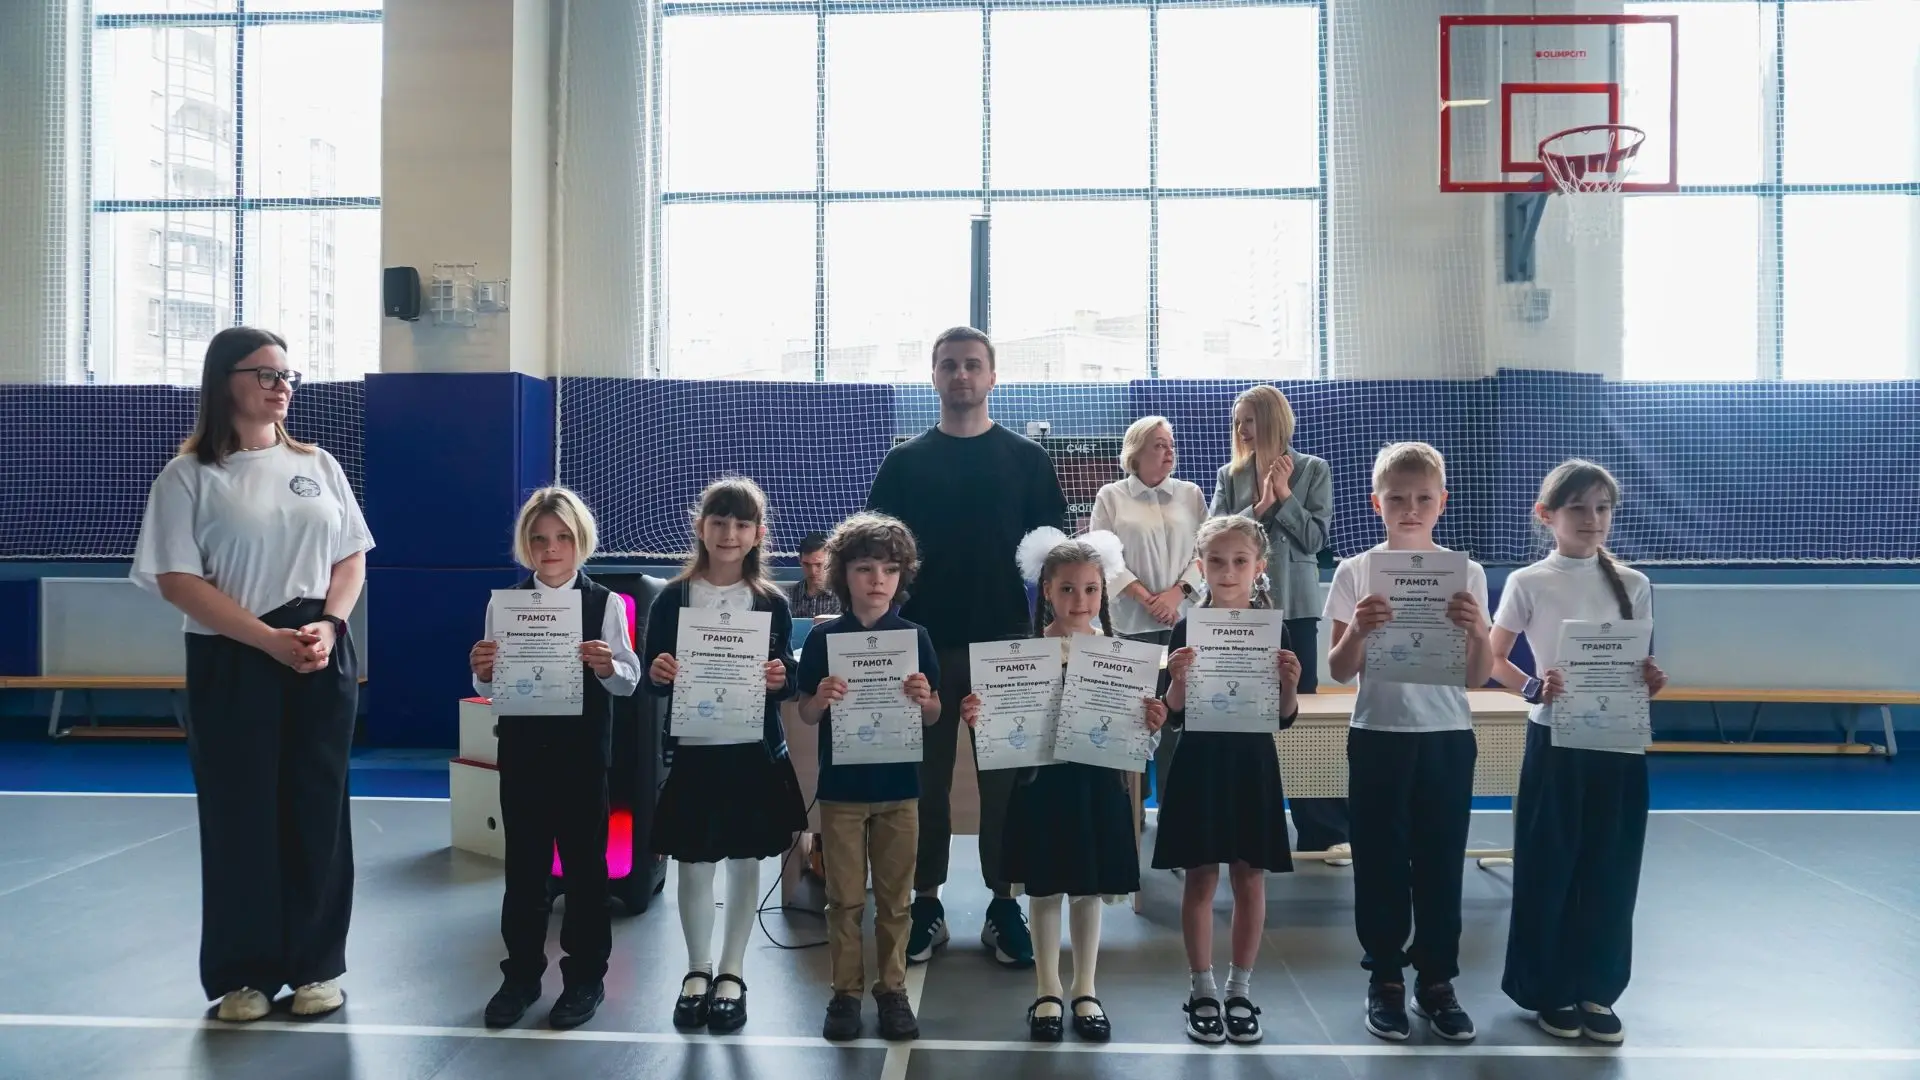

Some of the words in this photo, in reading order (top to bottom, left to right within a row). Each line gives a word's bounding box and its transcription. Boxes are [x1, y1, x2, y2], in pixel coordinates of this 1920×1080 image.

[1066, 444, 1097, 453] СЧЕТ
[1394, 578, 1439, 586] ГРАМОТА
[517, 614, 557, 622] ГРАМОТА
[1212, 628, 1255, 636] ГРАМОТА
[702, 633, 744, 643] ГРАМОТА
[1582, 643, 1623, 651] ГРАМОТА
[852, 658, 893, 668] ГРАМОТА
[995, 663, 1037, 672] ГРАМОТА
[1092, 660, 1134, 674] ГРАМОТА
[985, 682, 1016, 690] Токарева
[1079, 675, 1109, 686] Токарева
[1110, 681, 1144, 691] Екатерина
